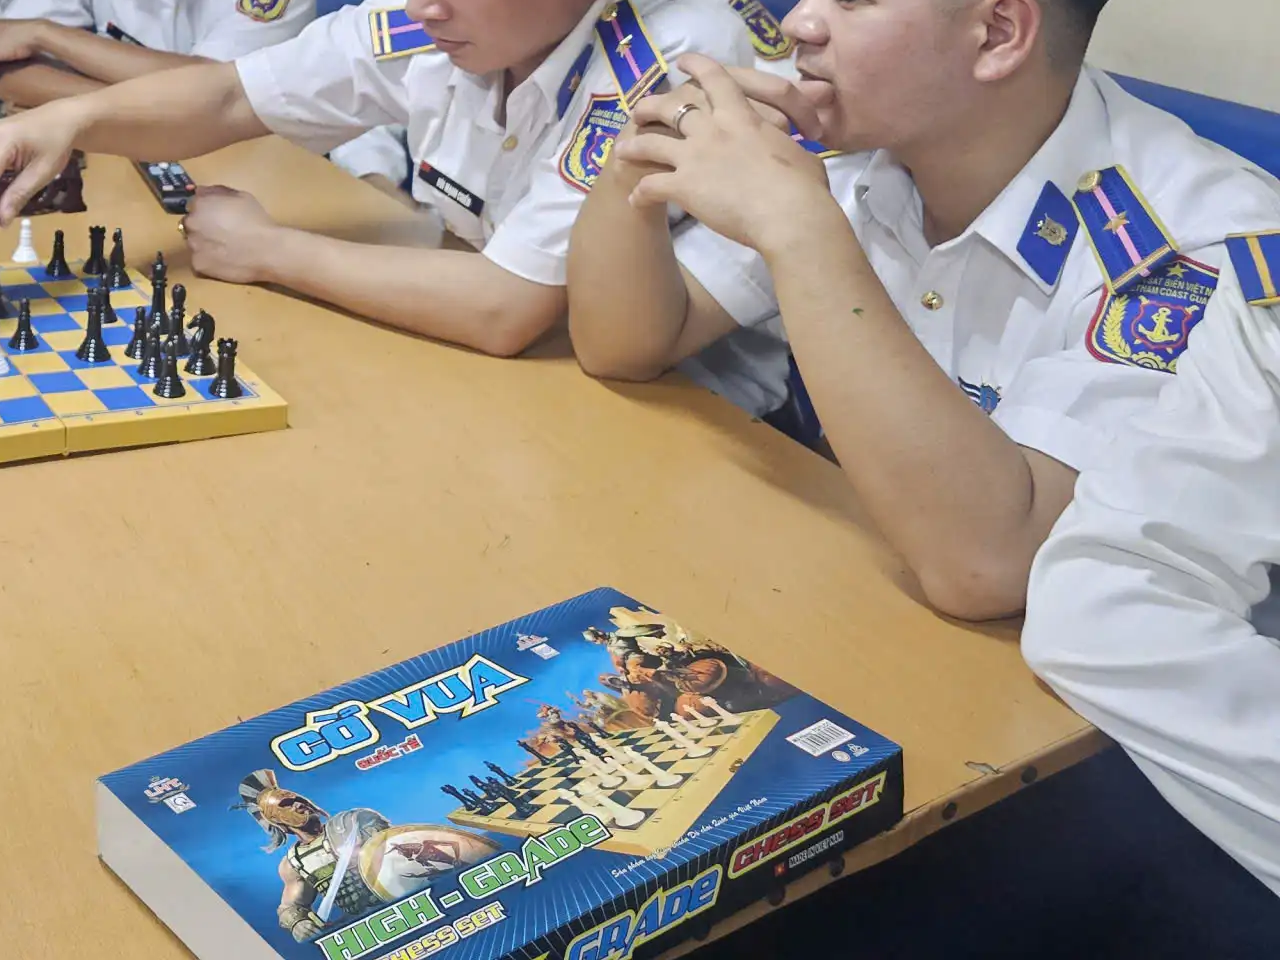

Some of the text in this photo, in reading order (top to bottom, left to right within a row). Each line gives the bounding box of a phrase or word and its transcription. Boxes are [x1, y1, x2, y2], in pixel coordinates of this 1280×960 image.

[1160, 288, 1189, 300] COAST
[378, 660, 516, 723] VUA
[320, 894, 441, 960] HIGH
[461, 817, 608, 898] GRADE
